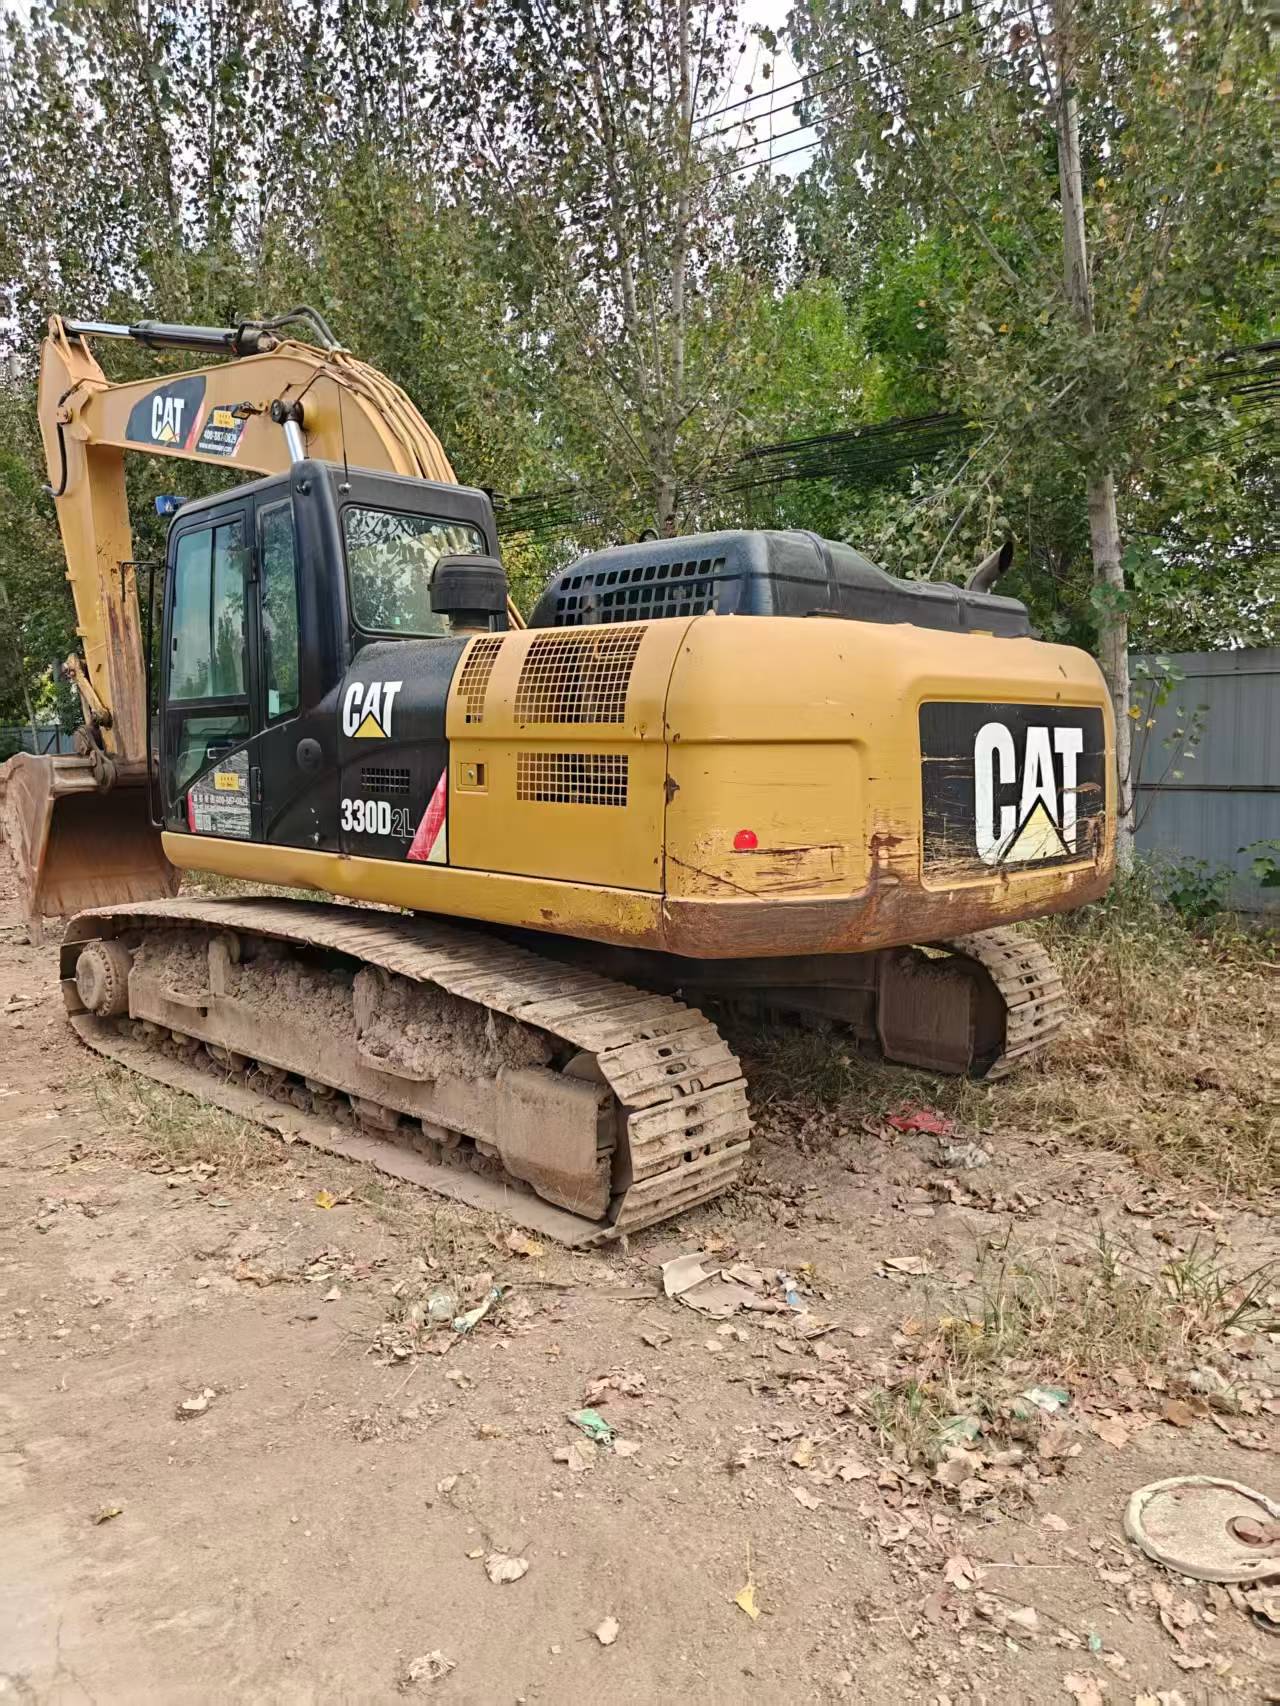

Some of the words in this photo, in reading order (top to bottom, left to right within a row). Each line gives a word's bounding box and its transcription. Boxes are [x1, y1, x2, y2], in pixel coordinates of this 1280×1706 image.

[151, 396, 185, 442] CAT
[343, 681, 402, 738] CAT
[974, 722, 1084, 865] CAT
